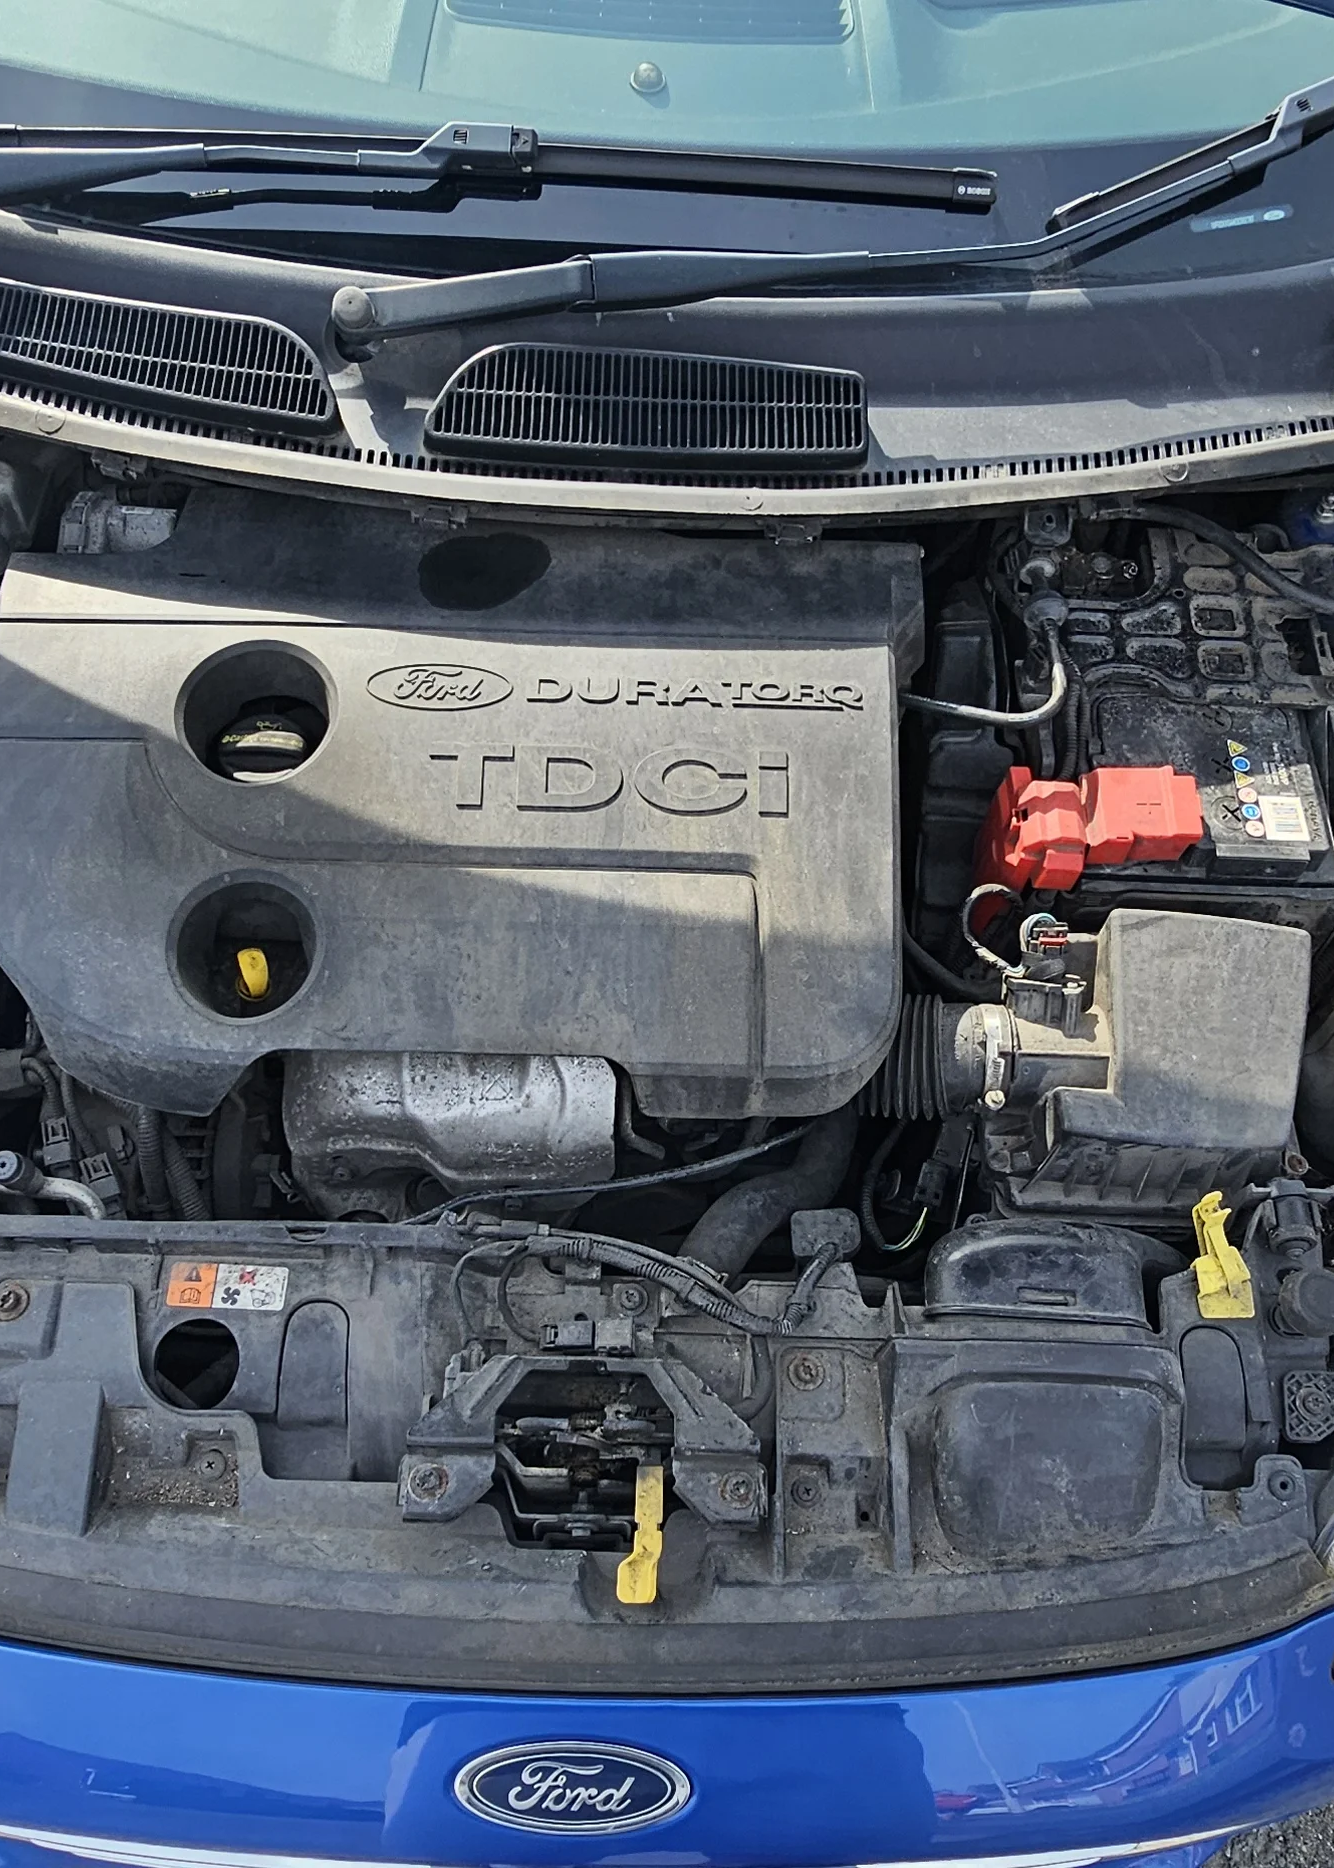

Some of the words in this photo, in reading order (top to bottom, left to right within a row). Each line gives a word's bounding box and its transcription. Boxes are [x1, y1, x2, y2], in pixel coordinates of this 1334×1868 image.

[393, 668, 487, 702] Ford
[526, 677, 864, 712] DURATORQ
[429, 742, 789, 818] TDCi
[507, 1761, 636, 1813] Ford
